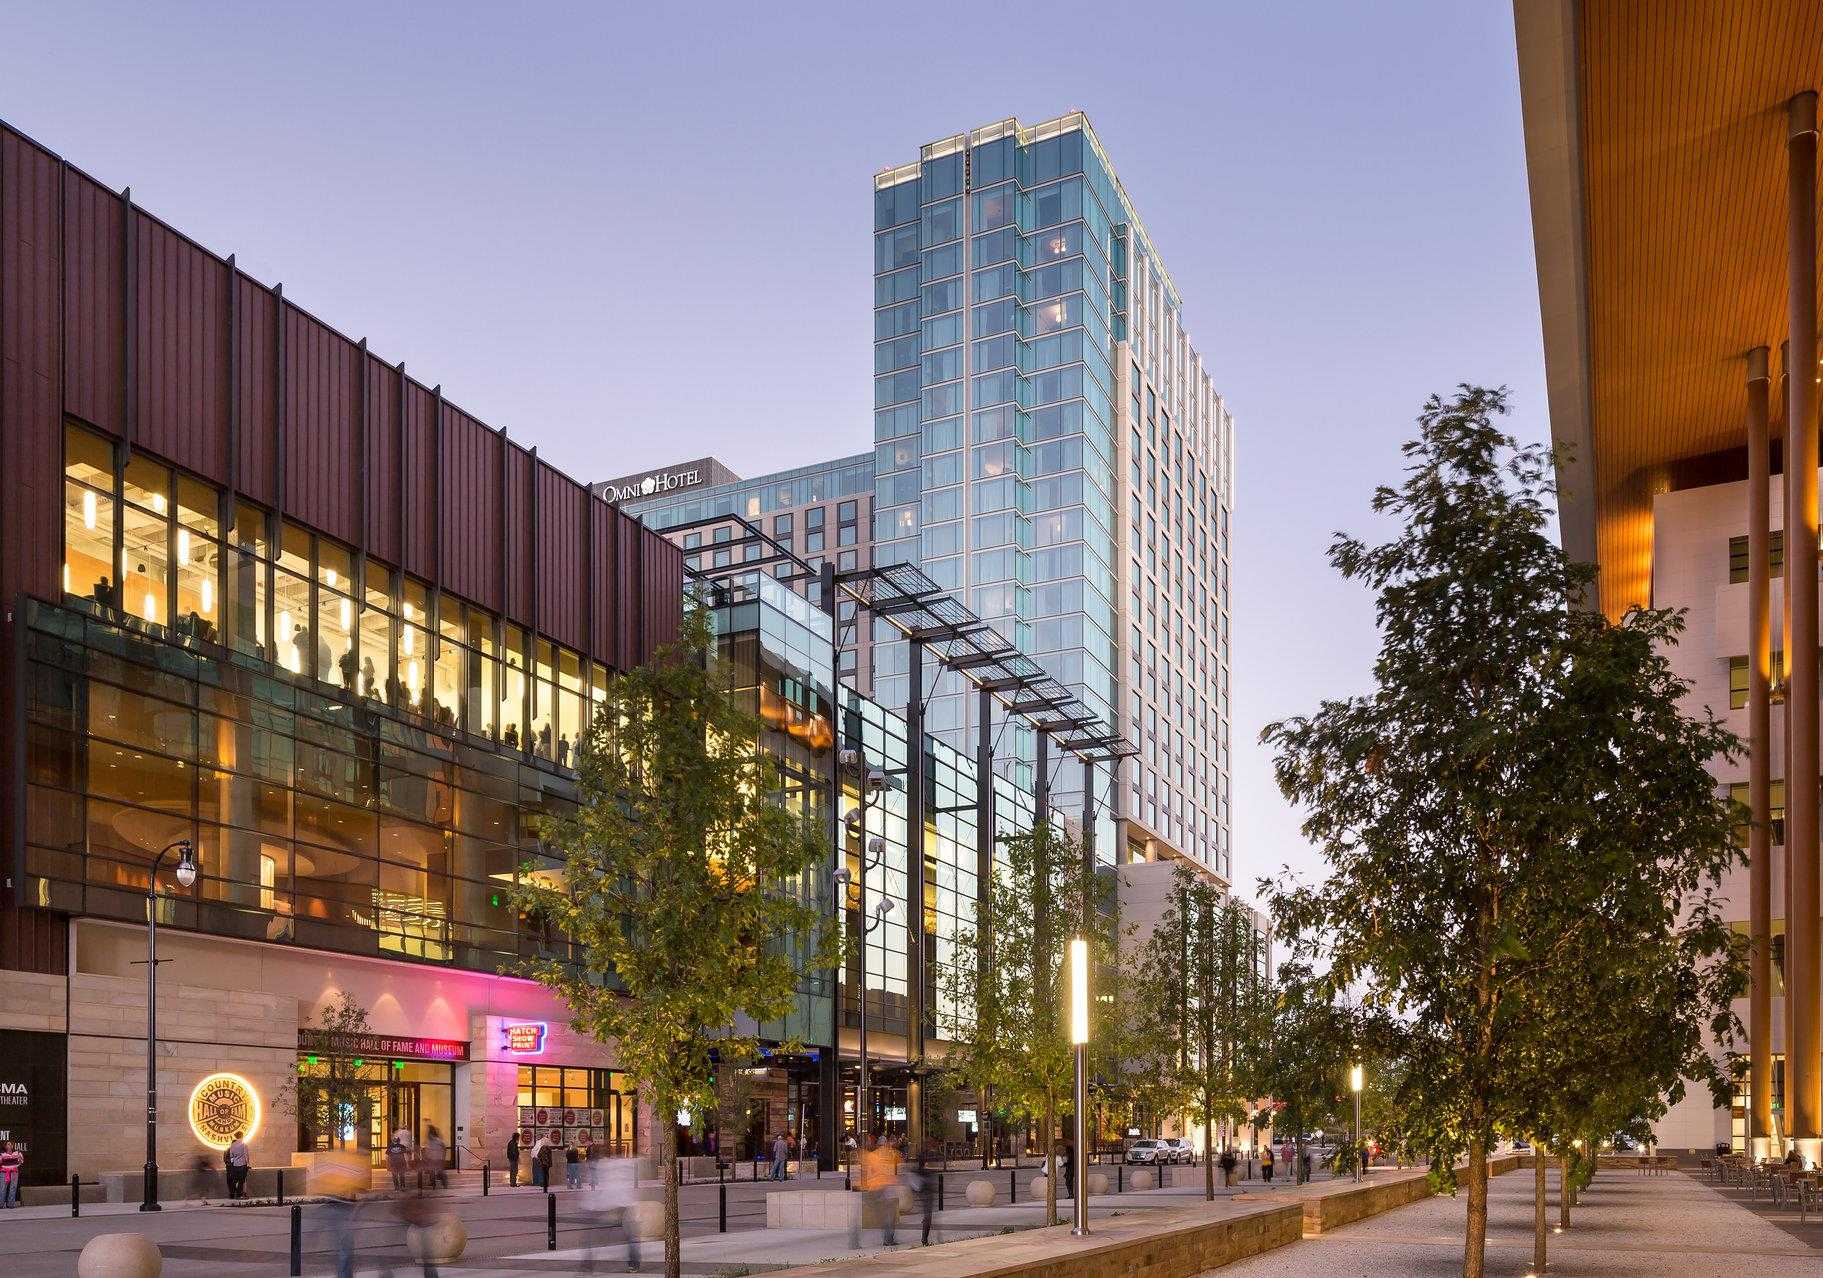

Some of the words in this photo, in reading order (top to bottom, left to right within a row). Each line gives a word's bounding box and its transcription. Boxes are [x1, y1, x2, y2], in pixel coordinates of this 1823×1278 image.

[603, 485, 640, 503] OMNI
[655, 469, 703, 493] HOTEL
[381, 1040, 391, 1052] OF
[392, 1041, 414, 1053] FAME
[414, 1043, 430, 1054] AND
[431, 1043, 464, 1056] MUSEUM
[0, 1096, 28, 1105] THEATER
[208, 1089, 241, 1104] MUSIC
[193, 1100, 218, 1121] HALL
